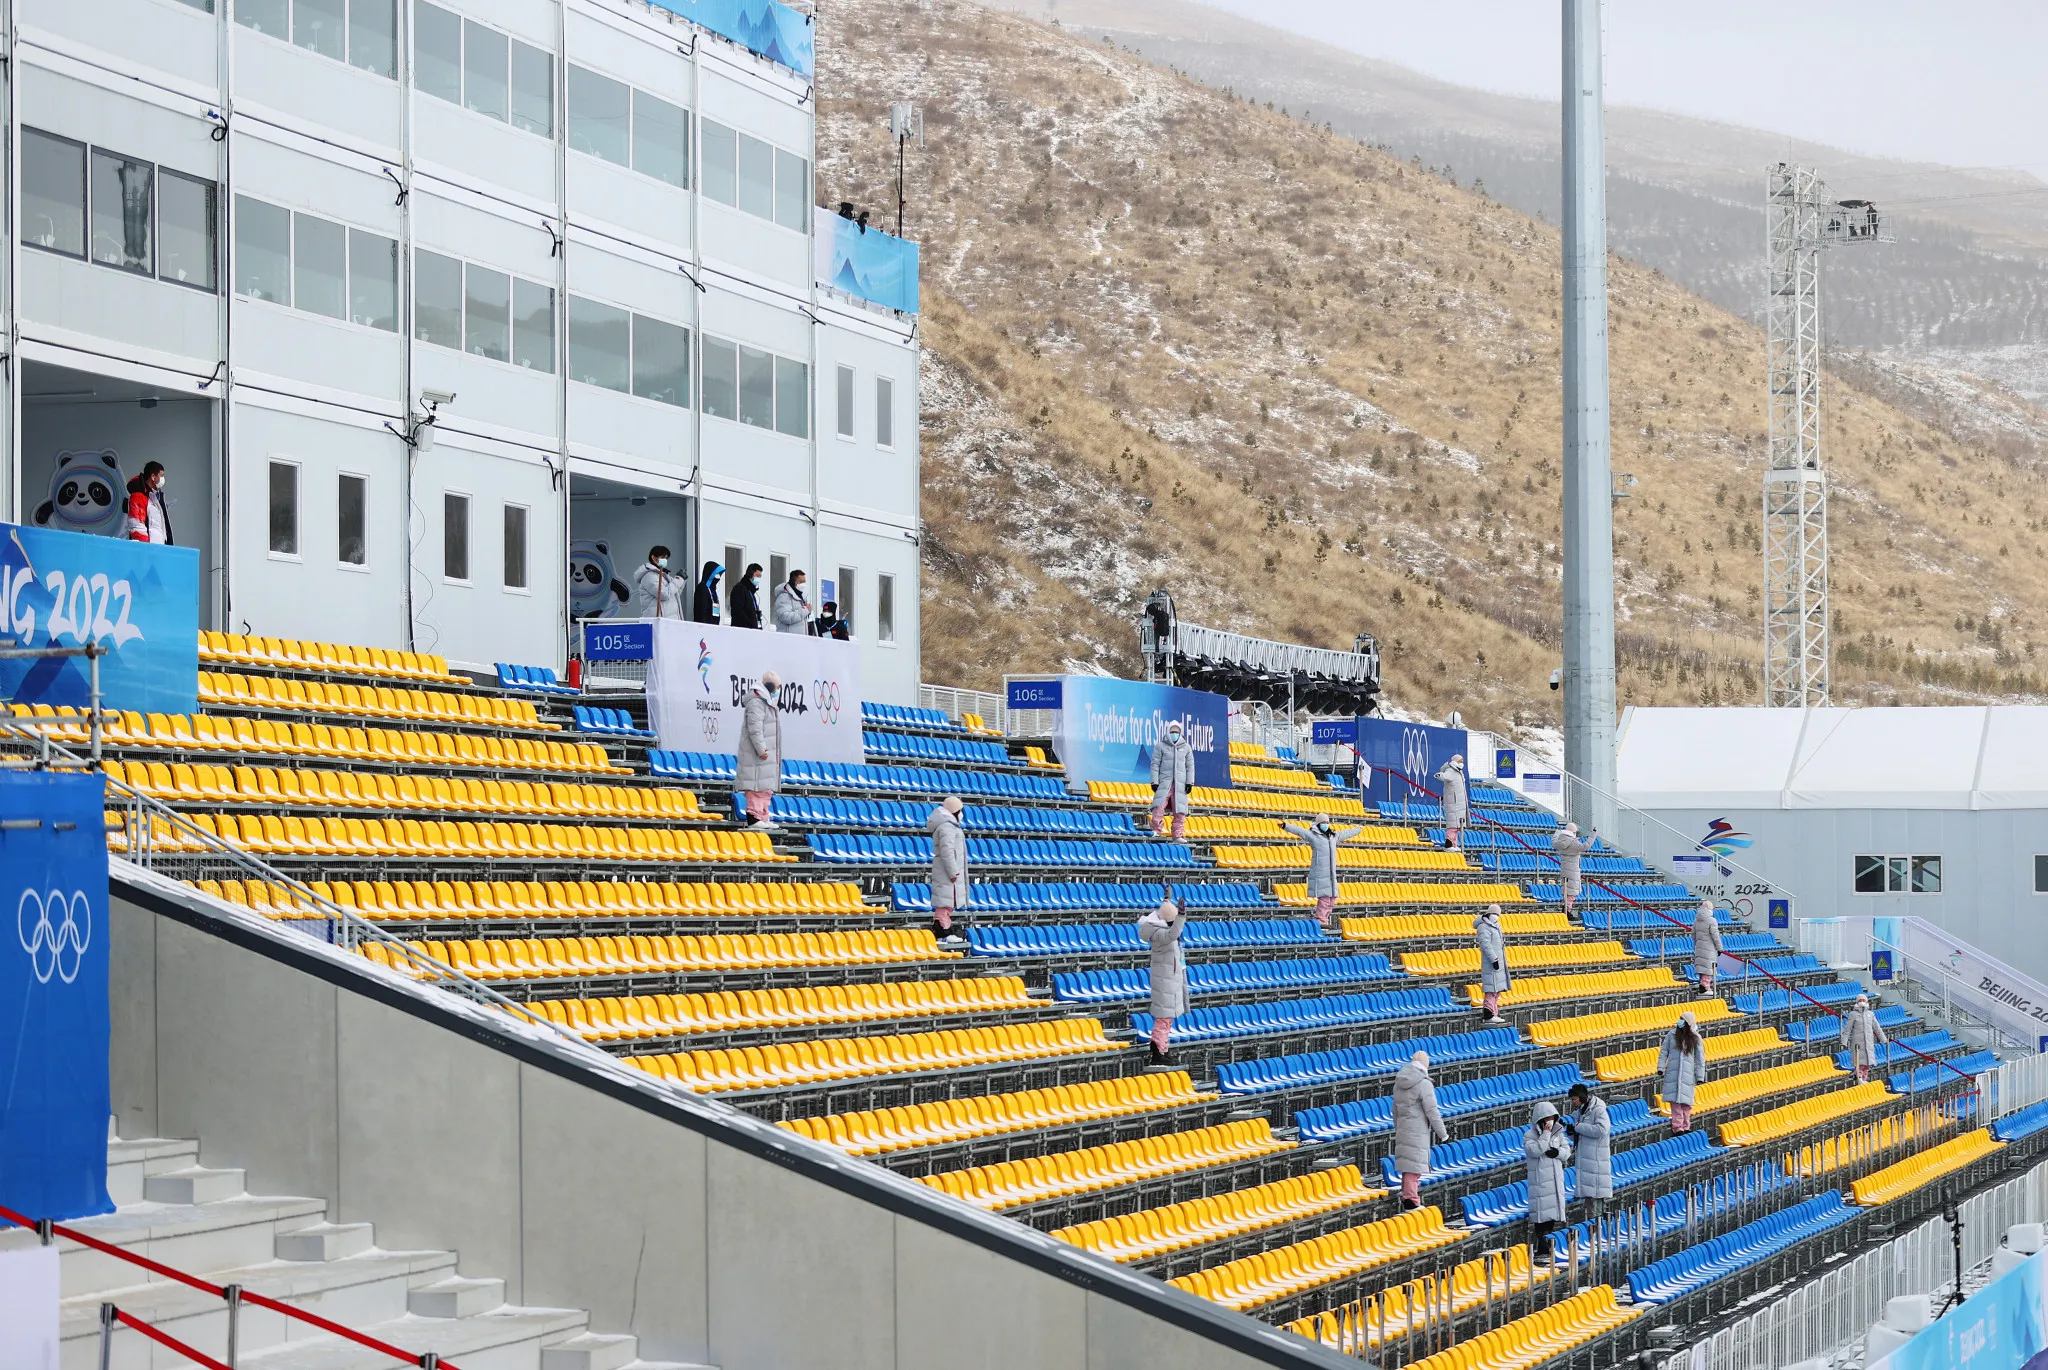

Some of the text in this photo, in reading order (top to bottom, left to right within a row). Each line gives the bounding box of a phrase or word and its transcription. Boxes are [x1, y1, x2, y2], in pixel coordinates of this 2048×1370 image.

[46, 570, 145, 649] 2022
[594, 634, 630, 650] 105 区
[777, 682, 808, 715] 2022
[1014, 689, 1038, 701] 106
[1085, 702, 1214, 753] Together for a Shad Future
[1317, 728, 1336, 739] 107
[1735, 884, 1773, 895] 2022
[1978, 976, 2031, 1012] BEIJING
